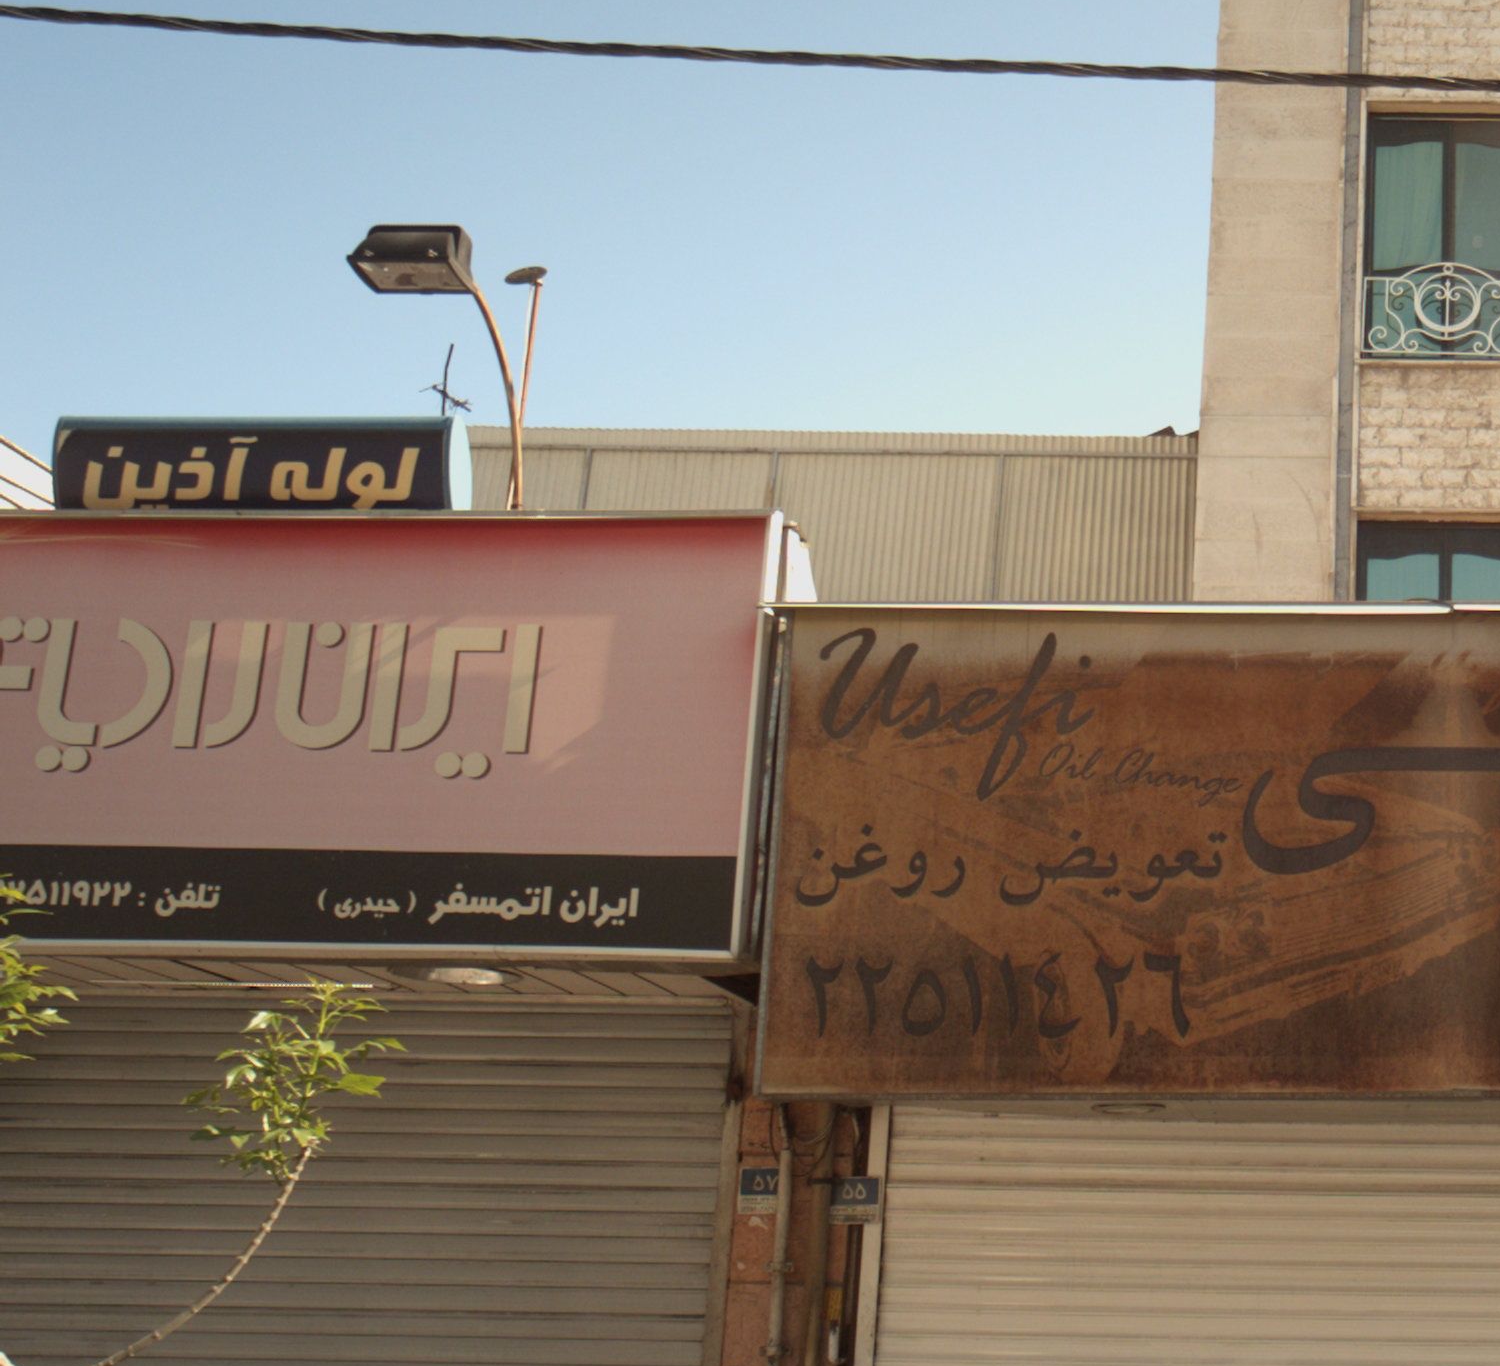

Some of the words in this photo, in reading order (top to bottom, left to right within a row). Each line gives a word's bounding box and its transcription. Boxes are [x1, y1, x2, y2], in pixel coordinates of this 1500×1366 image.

[82, 437, 258, 509] آذین
[270, 446, 420, 510] لوله
[274, 620, 542, 780] ایران
[820, 627, 1097, 802] Usefi
[1038, 743, 1099, 781] Oil
[1113, 748, 1244, 807] Change
[797, 823, 966, 906] روغن
[1000, 830, 1227, 904] تعویض
[428, 887, 551, 924] اتمسفر
[560, 888, 639, 926] ایران
